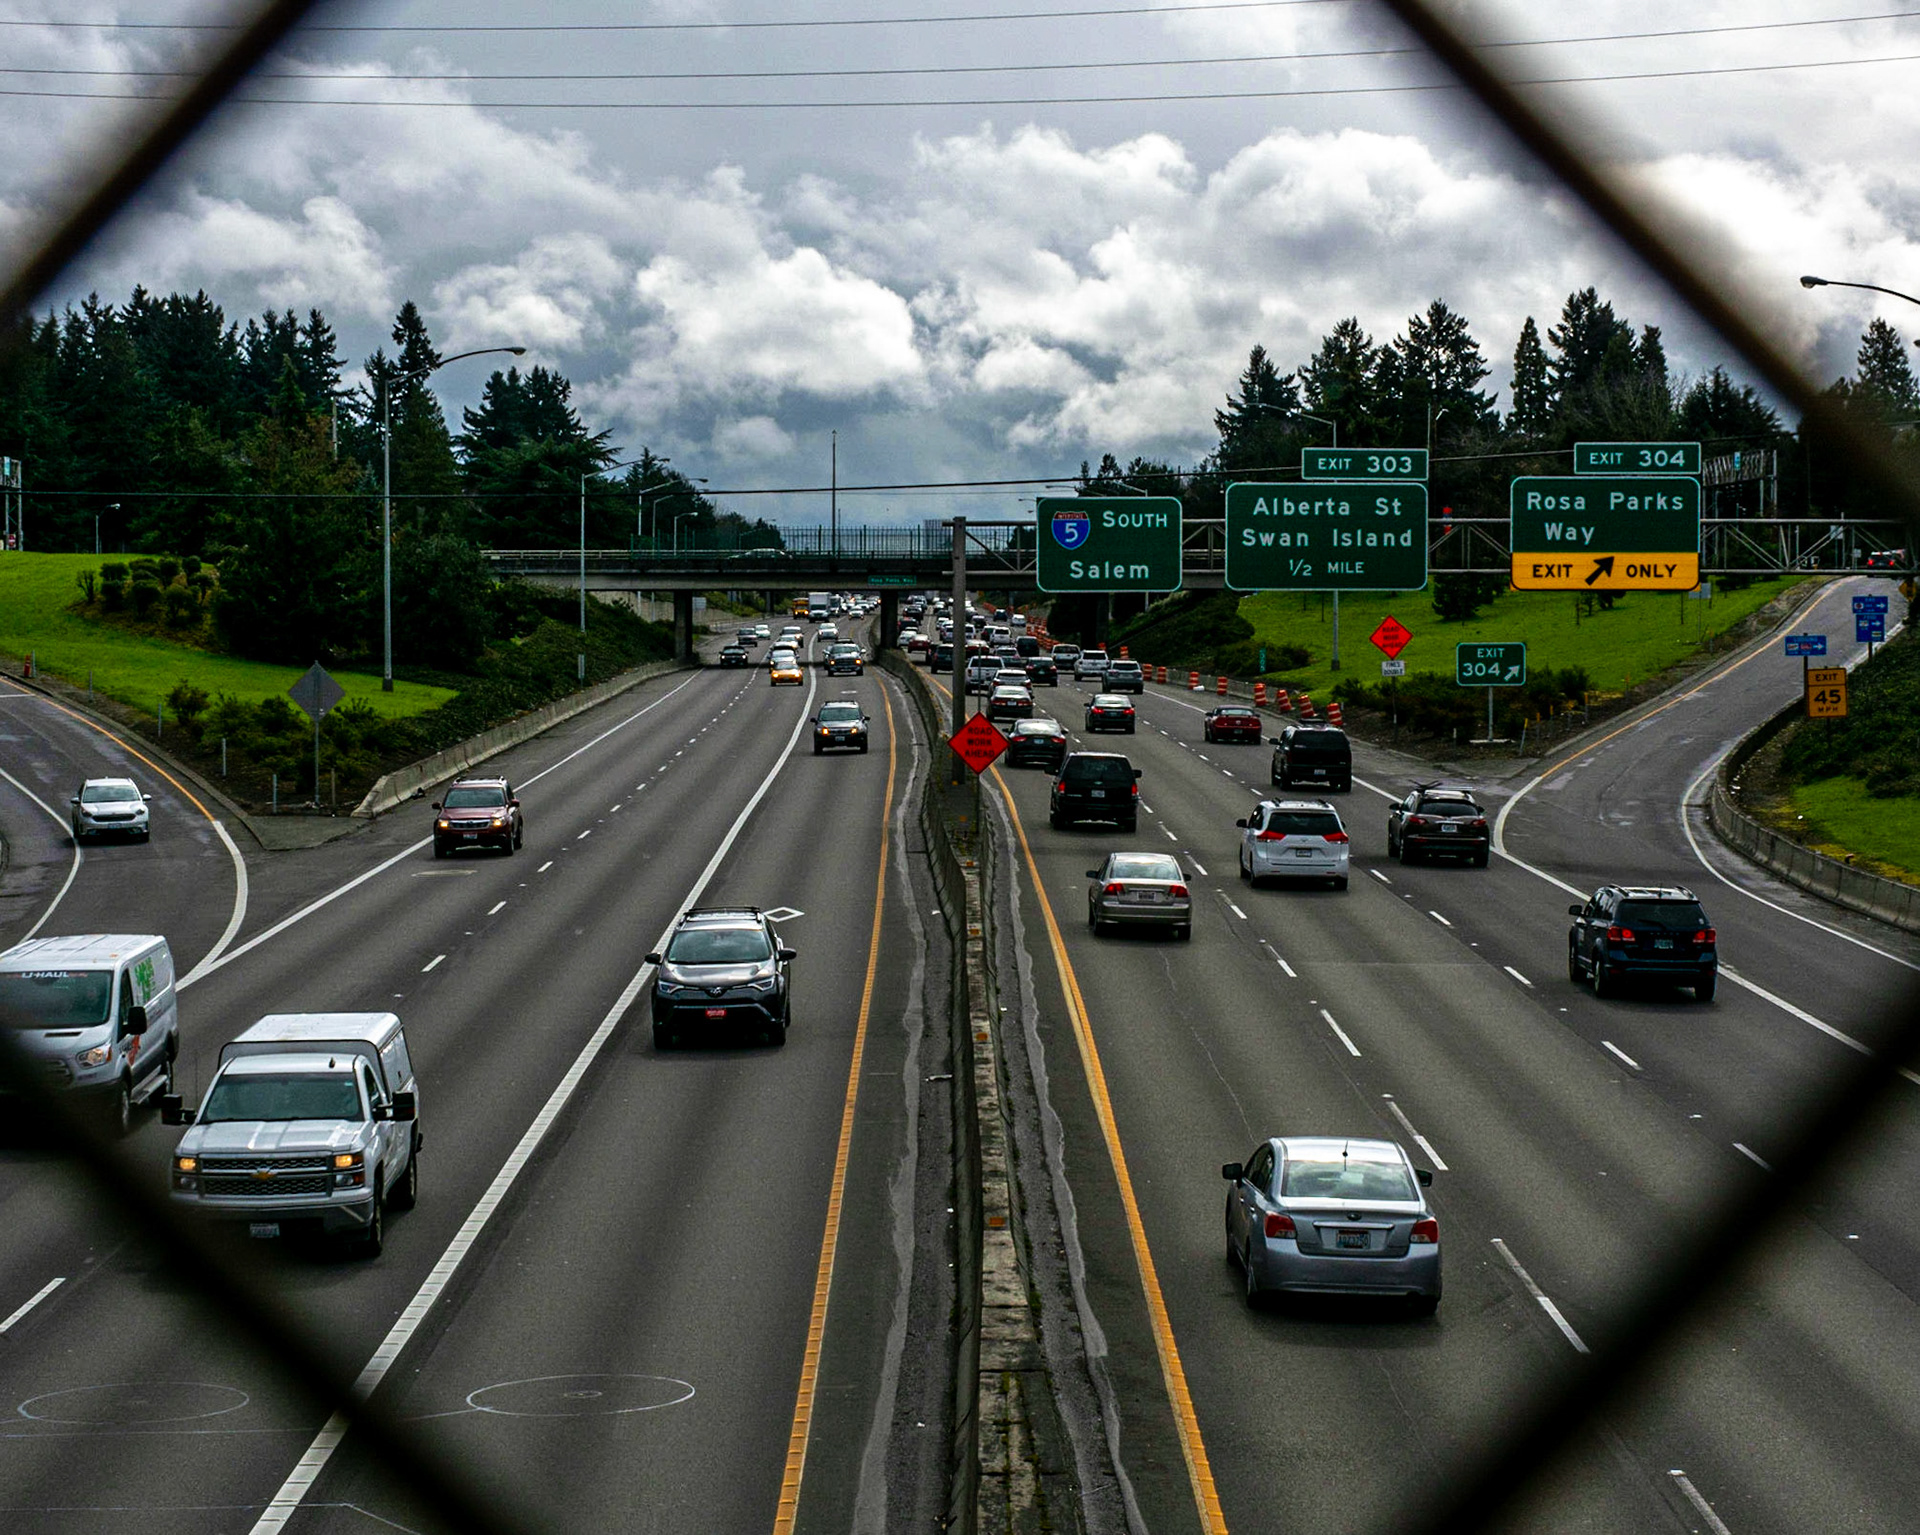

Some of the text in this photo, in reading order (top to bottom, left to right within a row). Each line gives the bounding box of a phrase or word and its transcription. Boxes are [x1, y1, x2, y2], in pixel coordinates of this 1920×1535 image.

[1317, 456, 1413, 473] EXIT 303
[1590, 450, 1685, 467] EXIT 304
[1253, 498, 1402, 516] Alberta St
[1527, 492, 1683, 510] Rosa Parks
[1064, 522, 1079, 543] 5
[1242, 528, 1412, 547] Swan Island
[1544, 522, 1595, 545] Way
[1069, 560, 1149, 579] Salem
[1327, 562, 1364, 574] MILE
[1532, 564, 1677, 578] EXIT ONLY
[1477, 648, 1505, 658] EXIT
[1462, 662, 1500, 676] 304
[1815, 673, 1838, 681] EXIT
[1814, 689, 1841, 704] 45
[967, 727, 993, 735] ROAD
[967, 738, 993, 746] WORK
[965, 750, 995, 758] AHEAD
